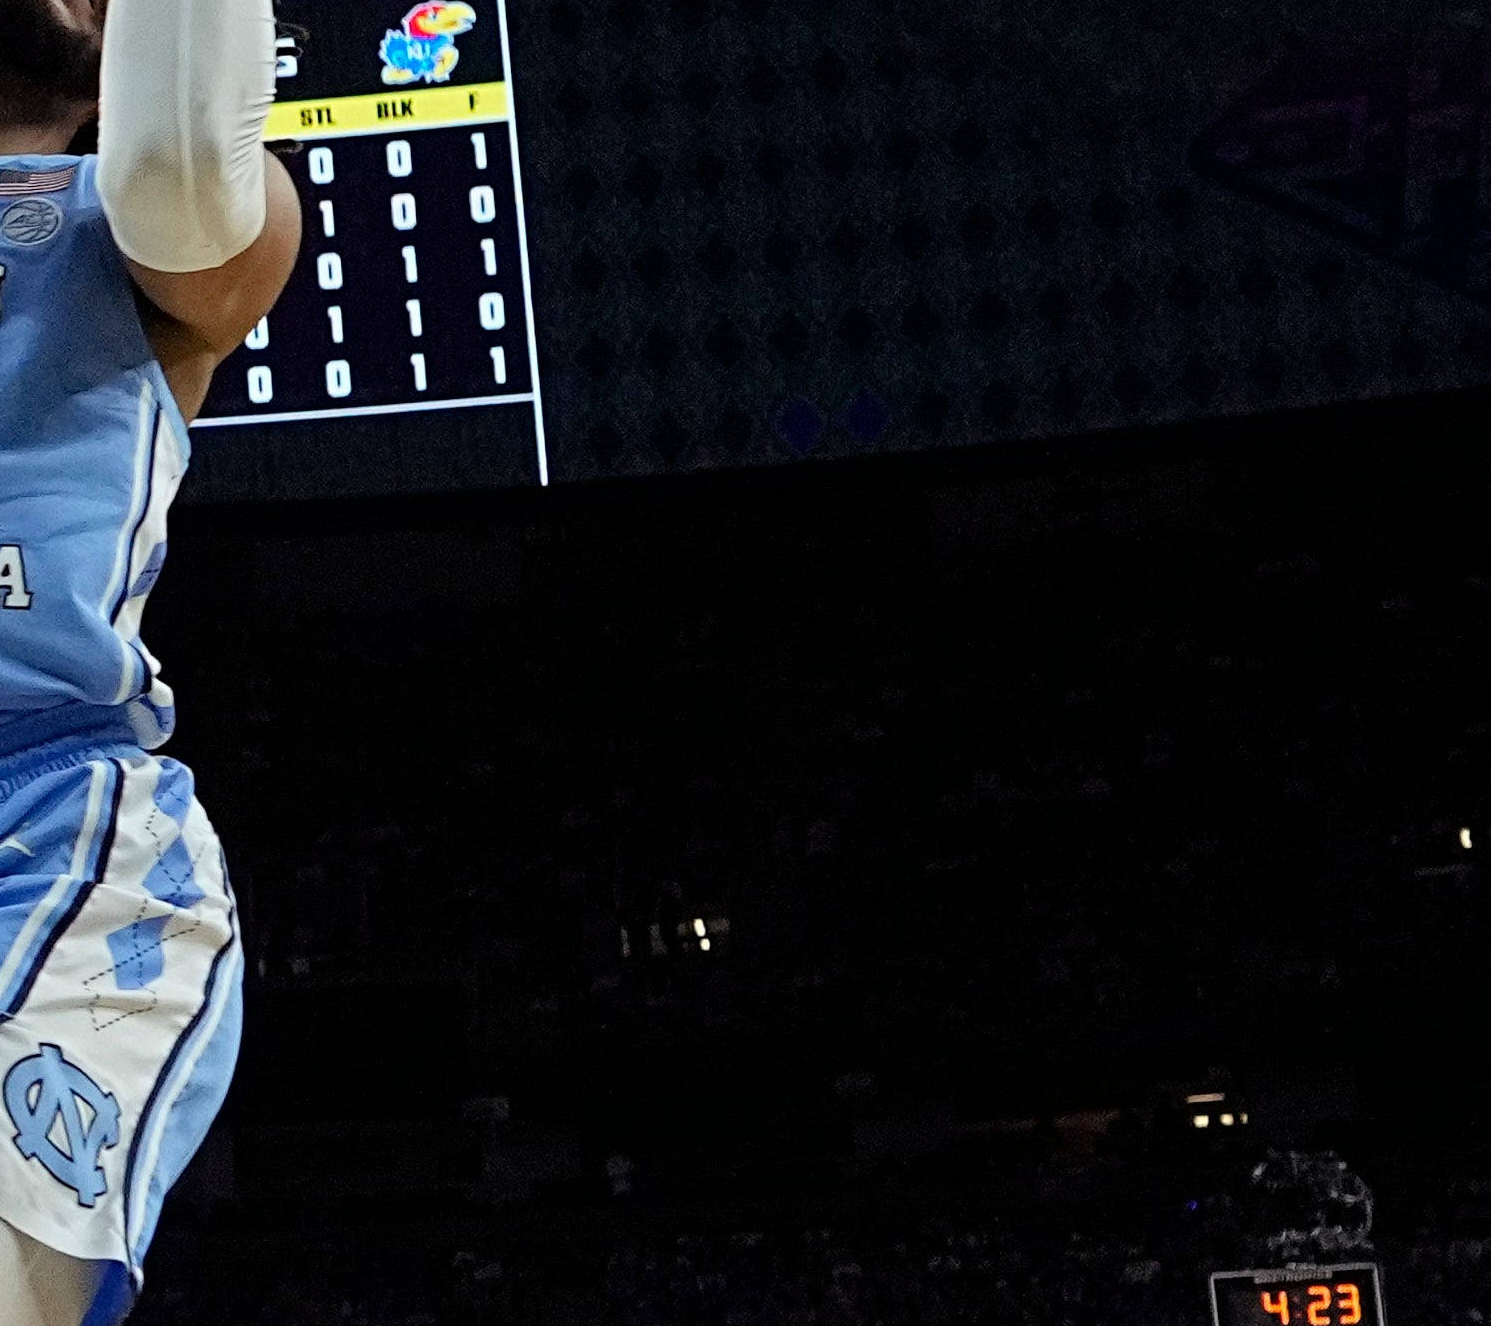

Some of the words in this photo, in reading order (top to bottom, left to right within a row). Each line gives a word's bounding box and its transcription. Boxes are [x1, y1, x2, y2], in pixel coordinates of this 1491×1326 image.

[299, 106, 337, 127] STL
[376, 98, 415, 121] BLK
[468, 92, 481, 112] F
[307, 146, 335, 185] 0
[385, 139, 414, 177] 0
[469, 131, 488, 170] 1
[318, 199, 336, 237] 1
[390, 192, 418, 231] 0
[468, 185, 497, 224] 0
[316, 252, 344, 290] 0
[401, 245, 419, 283] 1
[480, 237, 498, 276] 1
[327, 304, 345, 344] 1
[405, 298, 423, 337] 1
[478, 291, 506, 331] 0
[246, 365, 274, 404] 0
[324, 359, 352, 398] 0
[409, 352, 427, 392] 1
[489, 345, 507, 385] 1
